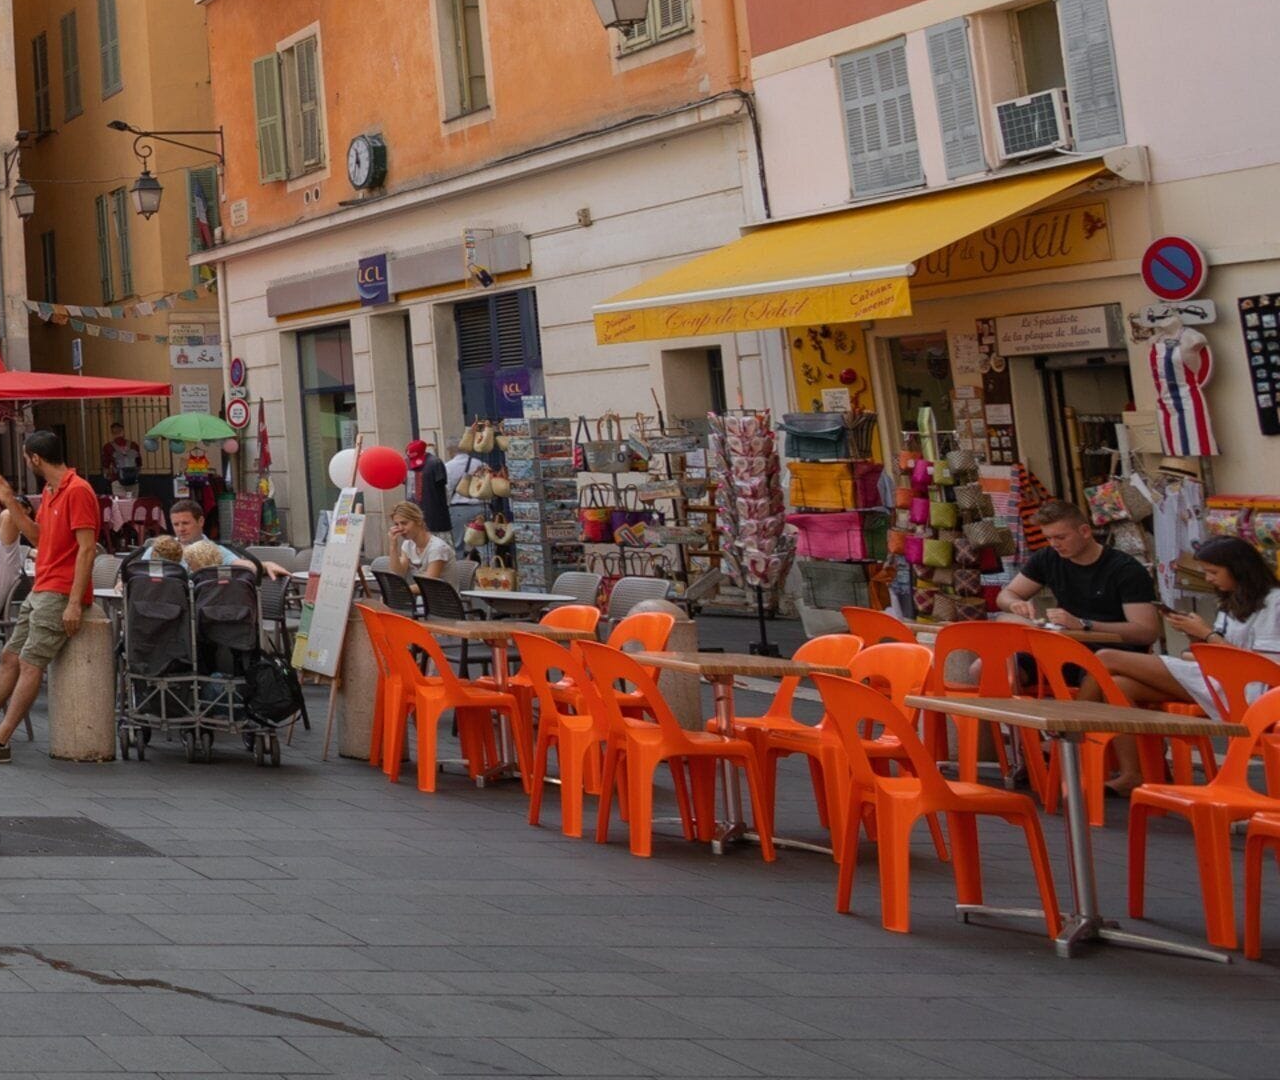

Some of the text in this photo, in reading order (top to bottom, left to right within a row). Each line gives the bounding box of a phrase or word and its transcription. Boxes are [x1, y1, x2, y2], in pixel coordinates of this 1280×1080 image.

[980, 214, 1071, 273] Soleil
[358, 266, 384, 283] LCL
[850, 283, 893, 305] Cadeaux
[665, 295, 808, 335] Coup de Soleil
[1021, 318, 1031, 327] Le
[1025, 329, 1053, 342] plaque
[1056, 328, 1065, 337] de
[503, 383, 521, 393] LCL
